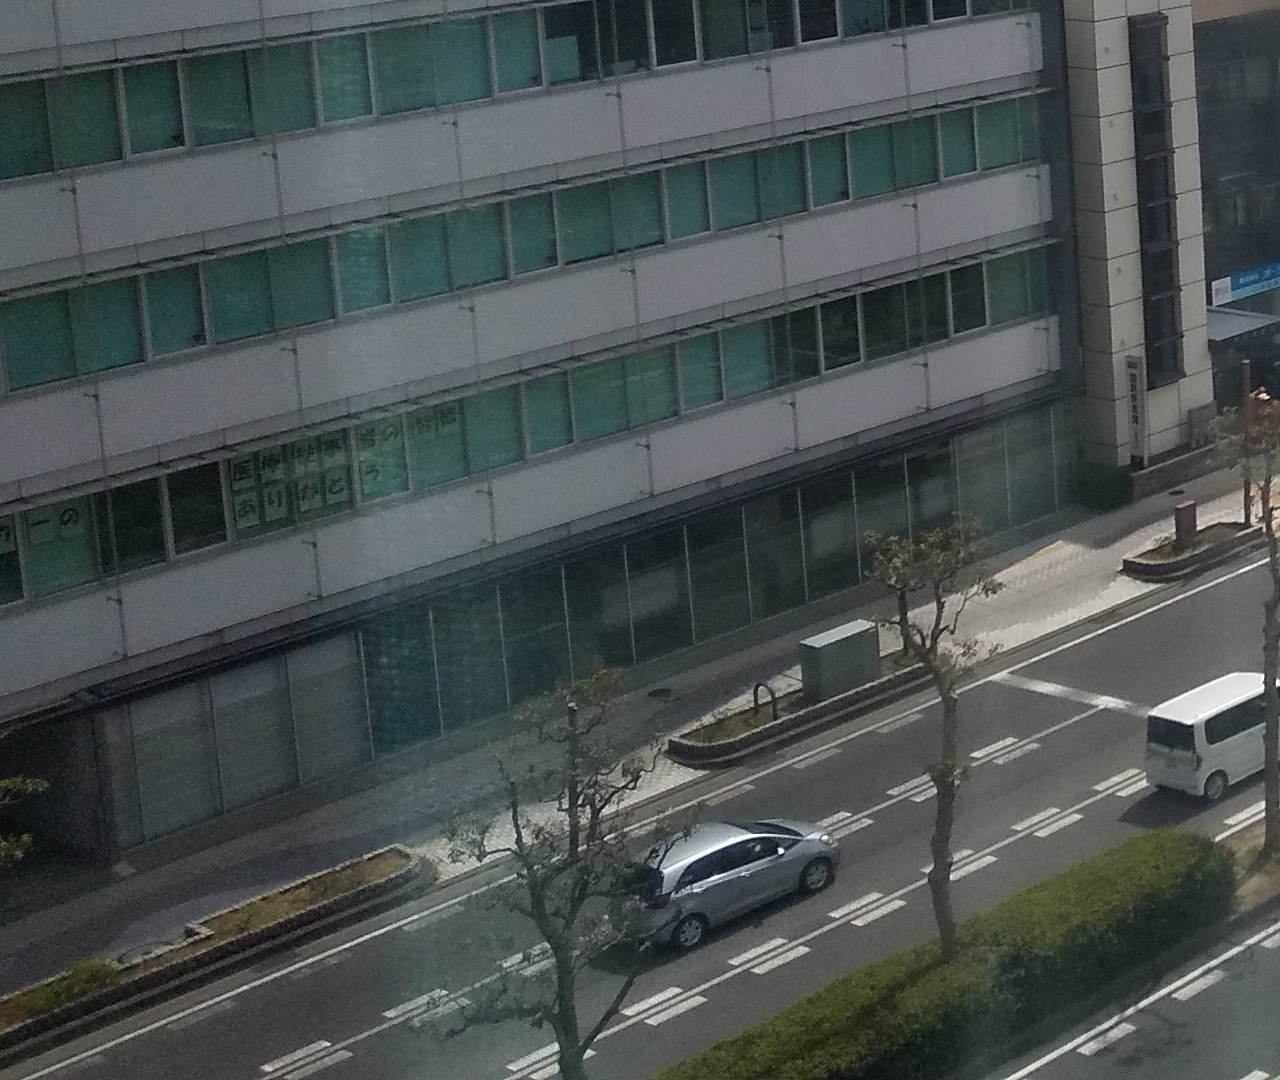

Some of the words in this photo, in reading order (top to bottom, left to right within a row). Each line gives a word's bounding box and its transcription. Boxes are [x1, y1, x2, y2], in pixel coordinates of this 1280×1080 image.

[237, 465, 381, 518] ありがとう
